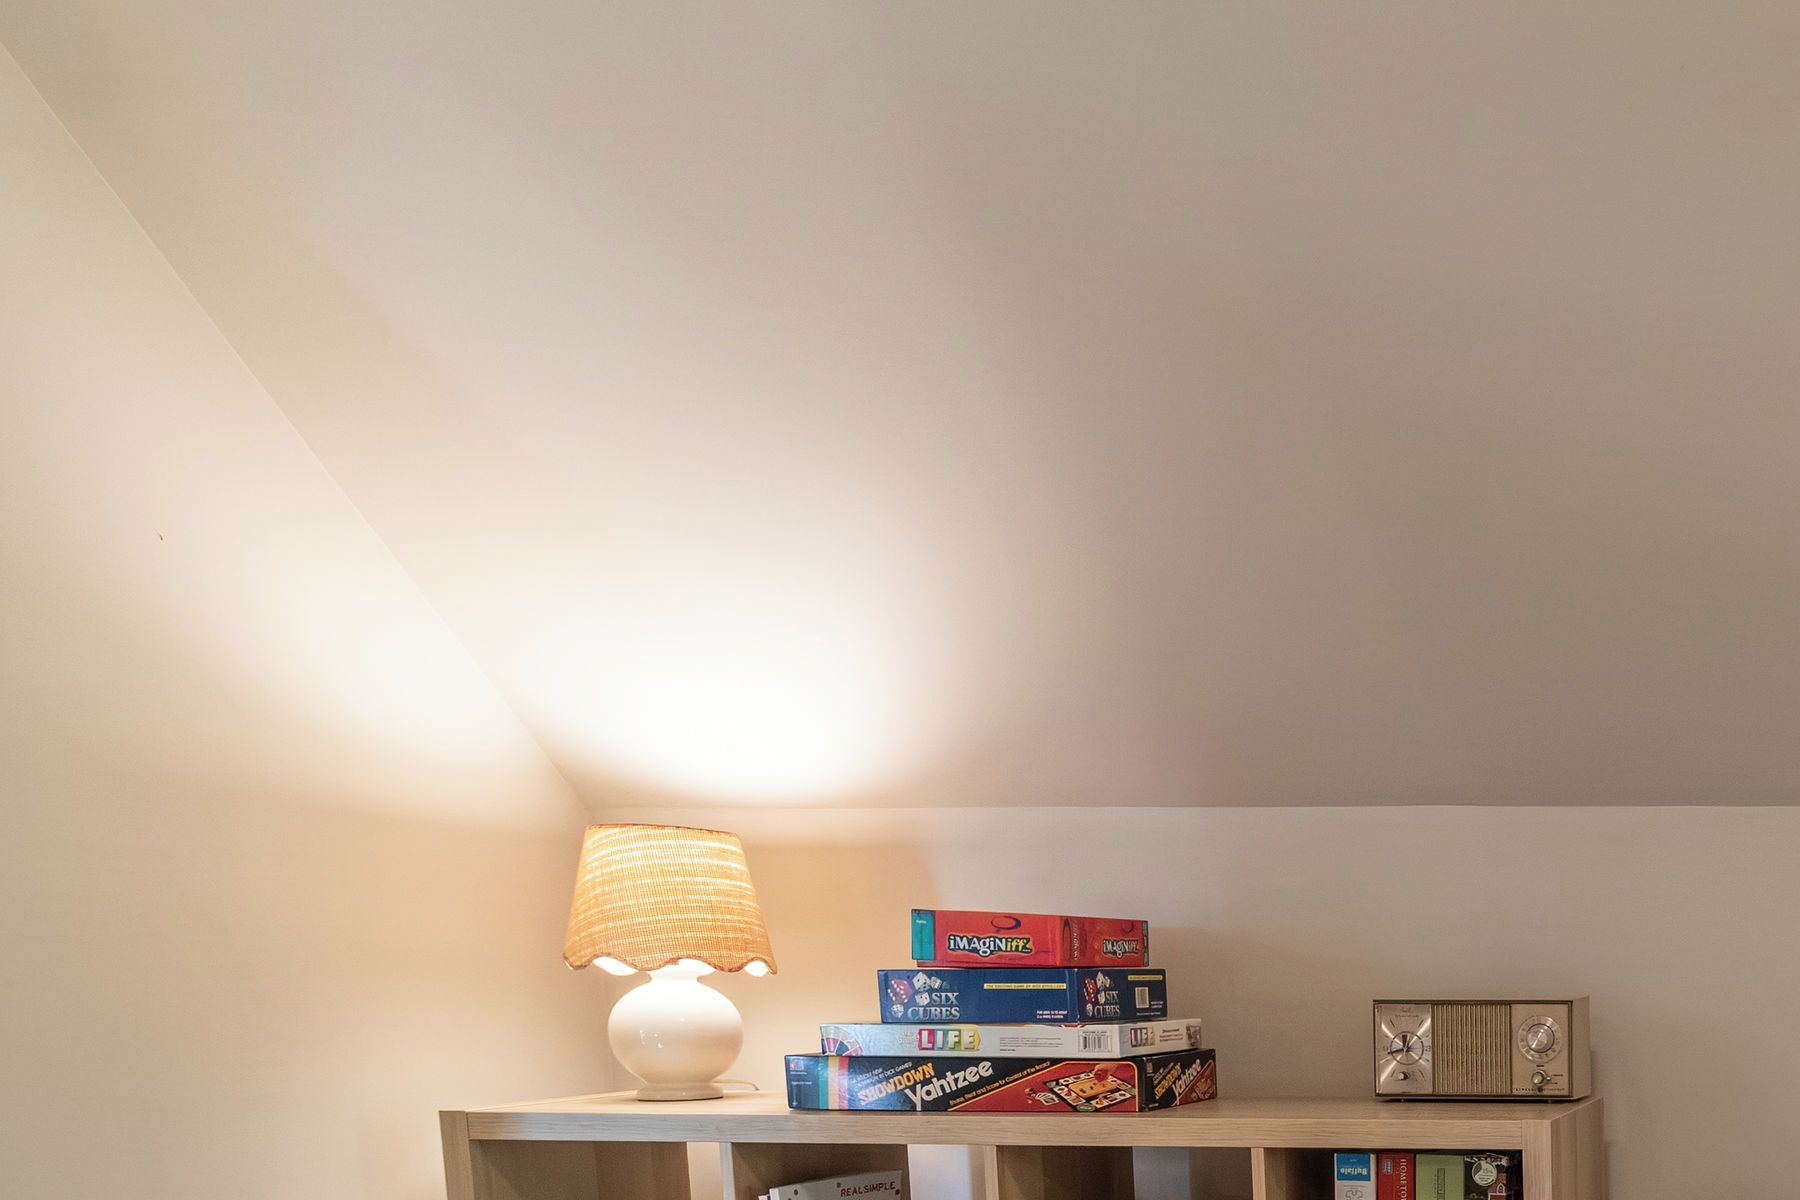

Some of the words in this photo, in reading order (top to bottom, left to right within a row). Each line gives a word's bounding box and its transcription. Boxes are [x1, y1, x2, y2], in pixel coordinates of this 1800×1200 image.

[931, 992, 959, 1005] SIX
[1106, 991, 1118, 1003] SIX
[907, 1007, 960, 1020] CUBES
[1094, 1005, 1120, 1017] CUBES
[921, 1029, 976, 1050] LIFE
[1130, 1026, 1155, 1048] LIFE
[858, 1062, 935, 1105] SHOWDOWN
[904, 1061, 993, 1111] Yahtzee
